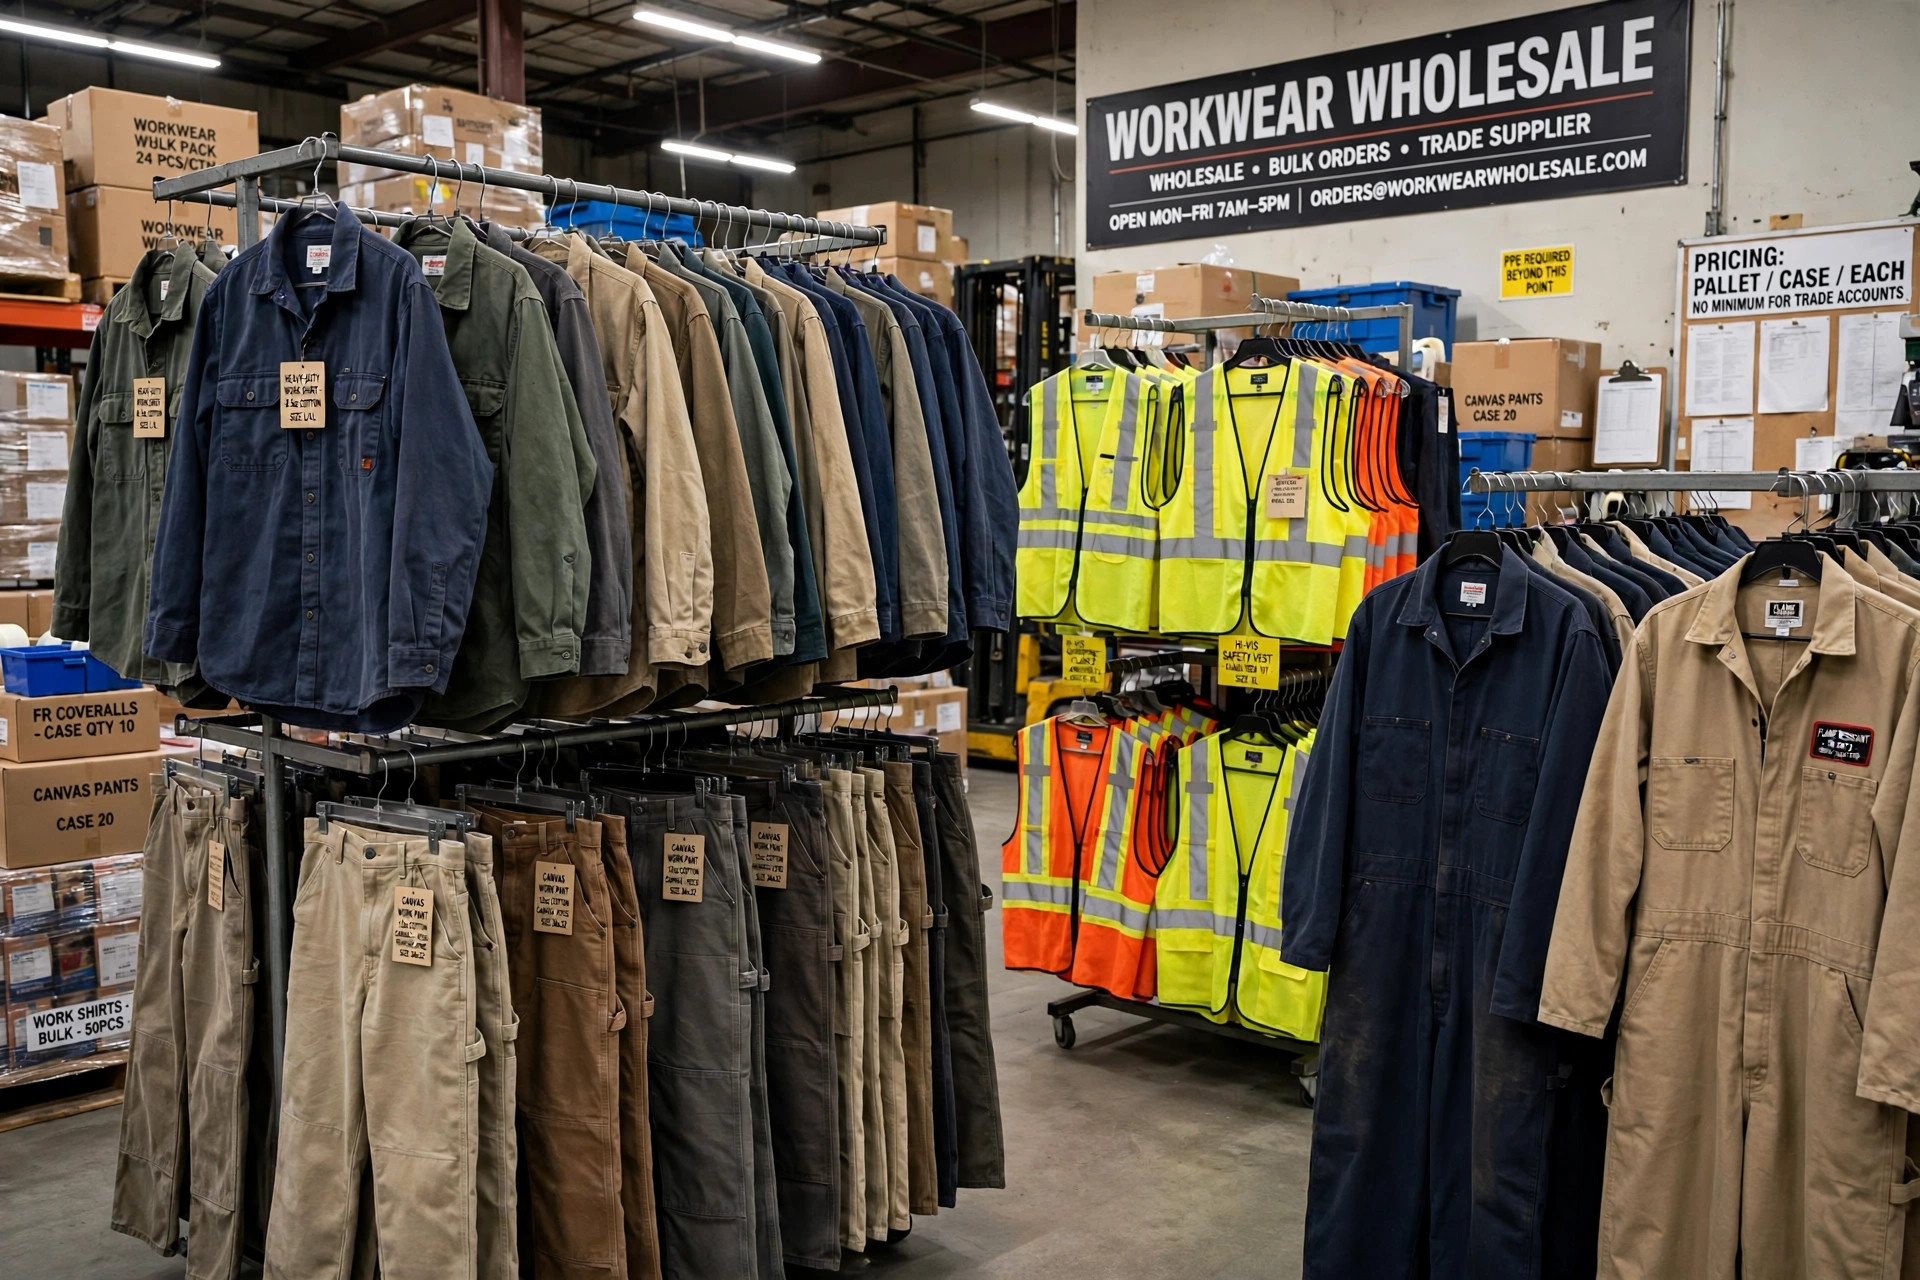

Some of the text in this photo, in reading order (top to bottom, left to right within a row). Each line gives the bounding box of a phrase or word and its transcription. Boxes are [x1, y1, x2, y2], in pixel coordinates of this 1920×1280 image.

[1105, 16, 1655, 162] WORKWEAR WHOLESALE
[134, 117, 216, 142] WORKWEAR
[136, 151, 153, 165] 24
[180, 140, 217, 158] PACK
[1149, 112, 1591, 192] WHOLESALE BULK ORDERS TRADE SUPPLIER
[1109, 211, 1147, 231] OPEN
[1310, 148, 1647, 207] ORDERS@WORKWEARWHOLESALE.COM
[1504, 250, 1571, 267] PPE REQUIRED
[1694, 246, 1784, 272] PRICING:
[1506, 265, 1567, 281] BEYOND THIS
[1694, 260, 1905, 296] PALLET / CASE / EACH
[1526, 281, 1554, 294] POINT
[1693, 286, 1904, 314] NO MINIMUM FOR TRADE ACCOUNTS
[1464, 392, 1543, 407] CANVAS PANTS
[1473, 409, 1517, 421] CASE 20
[1253, 653, 1273, 664] VEST
[33, 701, 138, 722] FR COVERALLS
[44, 723, 82, 739] CASE
[86, 720, 114, 736] QTY
[119, 719, 135, 733] 10
[33, 778, 139, 802] CANVAS PANTS
[56, 812, 114, 831] CASE 20
[672, 843, 696, 853] CANVAS
[543, 872, 565, 883] CANVAS
[33, 1009, 74, 1029] WORK
[77, 1000, 122, 1020] SHIRTS
[38, 1026, 73, 1045] BULK
[85, 1016, 124, 1036] 50PCS
